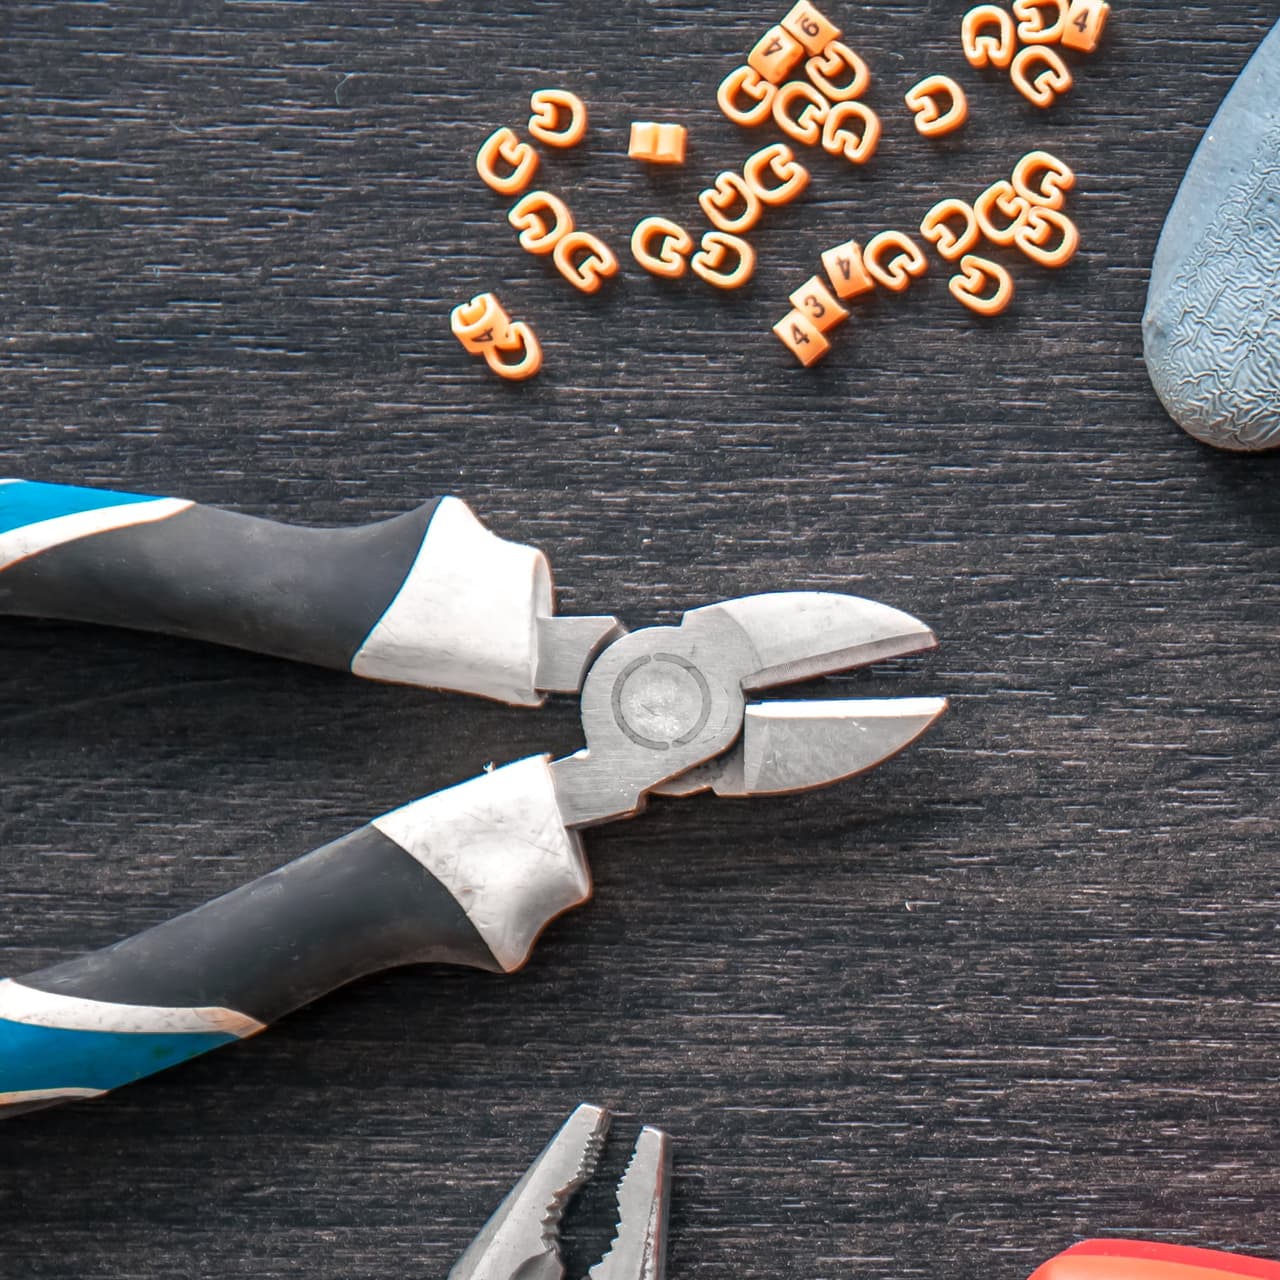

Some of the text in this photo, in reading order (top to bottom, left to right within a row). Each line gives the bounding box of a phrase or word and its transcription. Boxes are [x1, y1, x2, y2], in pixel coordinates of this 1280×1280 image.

[1073, 8, 1089, 33] 4
[804, 294, 825, 318] 3
[791, 322, 810, 344] 4
